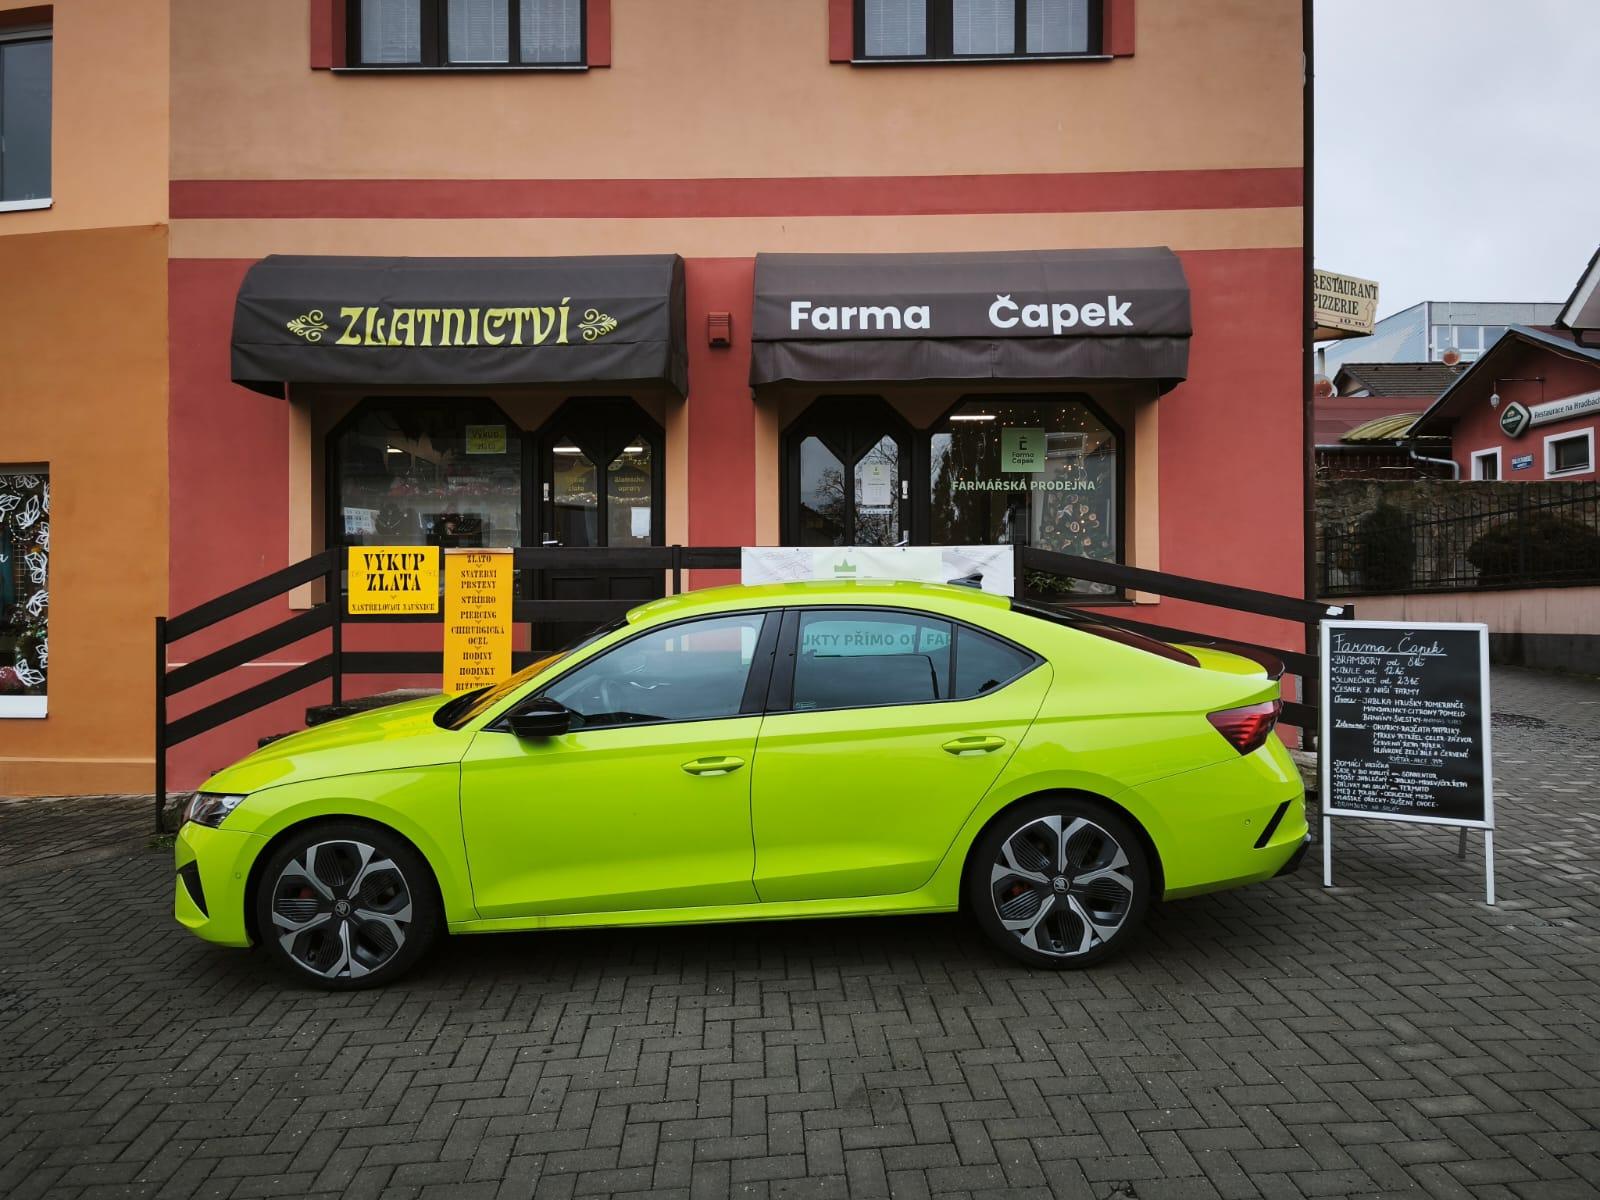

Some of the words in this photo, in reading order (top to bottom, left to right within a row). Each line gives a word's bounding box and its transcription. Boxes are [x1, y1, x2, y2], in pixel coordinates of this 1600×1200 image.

[790, 301, 930, 330] Farma
[988, 294, 1134, 335] Čapek
[335, 297, 571, 346] ZLATNICTVÍ
[952, 479, 1026, 491] FARMÁŘSKÁ
[1030, 480, 1096, 491] PRODEJNA
[363, 549, 425, 571] VÝKUP
[467, 554, 492, 563] ZLATO
[366, 573, 421, 591] ZLATA
[461, 580, 496, 589] PRSTENY
[460, 610, 497, 619] PIERCING
[468, 637, 488, 645] OCEL
[844, 631, 894, 646] PŘÍMO
[1333, 633, 1392, 653] Farma
[1398, 632, 1445, 660] Čapek
[463, 651, 493, 660] HODINY
[1335, 655, 1381, 665] BRAMBORY
[459, 667, 496, 676] HODINKY
[1335, 667, 1361, 675] CIBULE
[1335, 676, 1377, 684] SLUNEČNICE
[1335, 683, 1362, 693] ČESNEK
